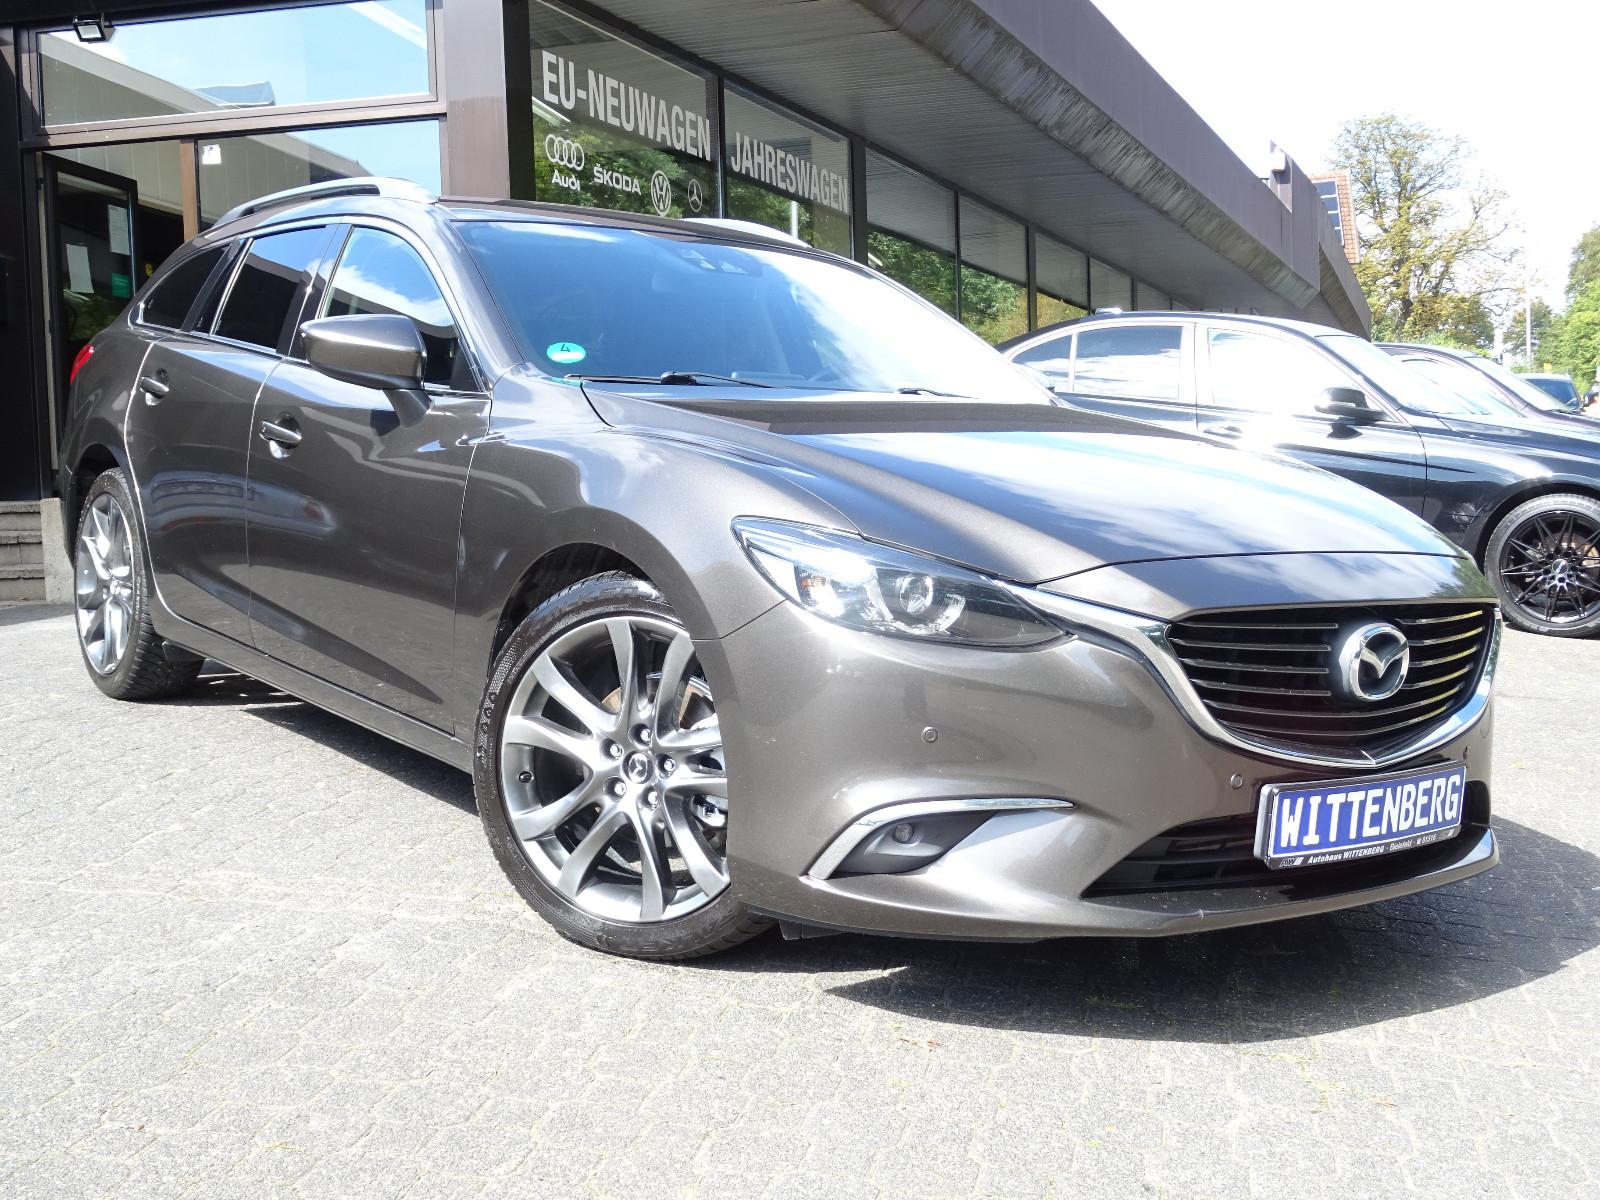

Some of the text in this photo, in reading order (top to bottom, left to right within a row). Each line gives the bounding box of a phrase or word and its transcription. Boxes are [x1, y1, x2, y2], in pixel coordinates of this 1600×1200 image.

[542, 50, 712, 162] EU-NEUWAGEN
[552, 169, 581, 191] Audi
[593, 163, 642, 195] ŠKODA
[731, 132, 850, 214] JAHRESWAGEN
[560, 343, 570, 352] 4
[1280, 774, 1461, 848] WITTENBERG
[1308, 853, 1342, 864] Autohaus
[1343, 845, 1385, 859] WITTENBERG
[1389, 839, 1413, 851] Bielefeld
